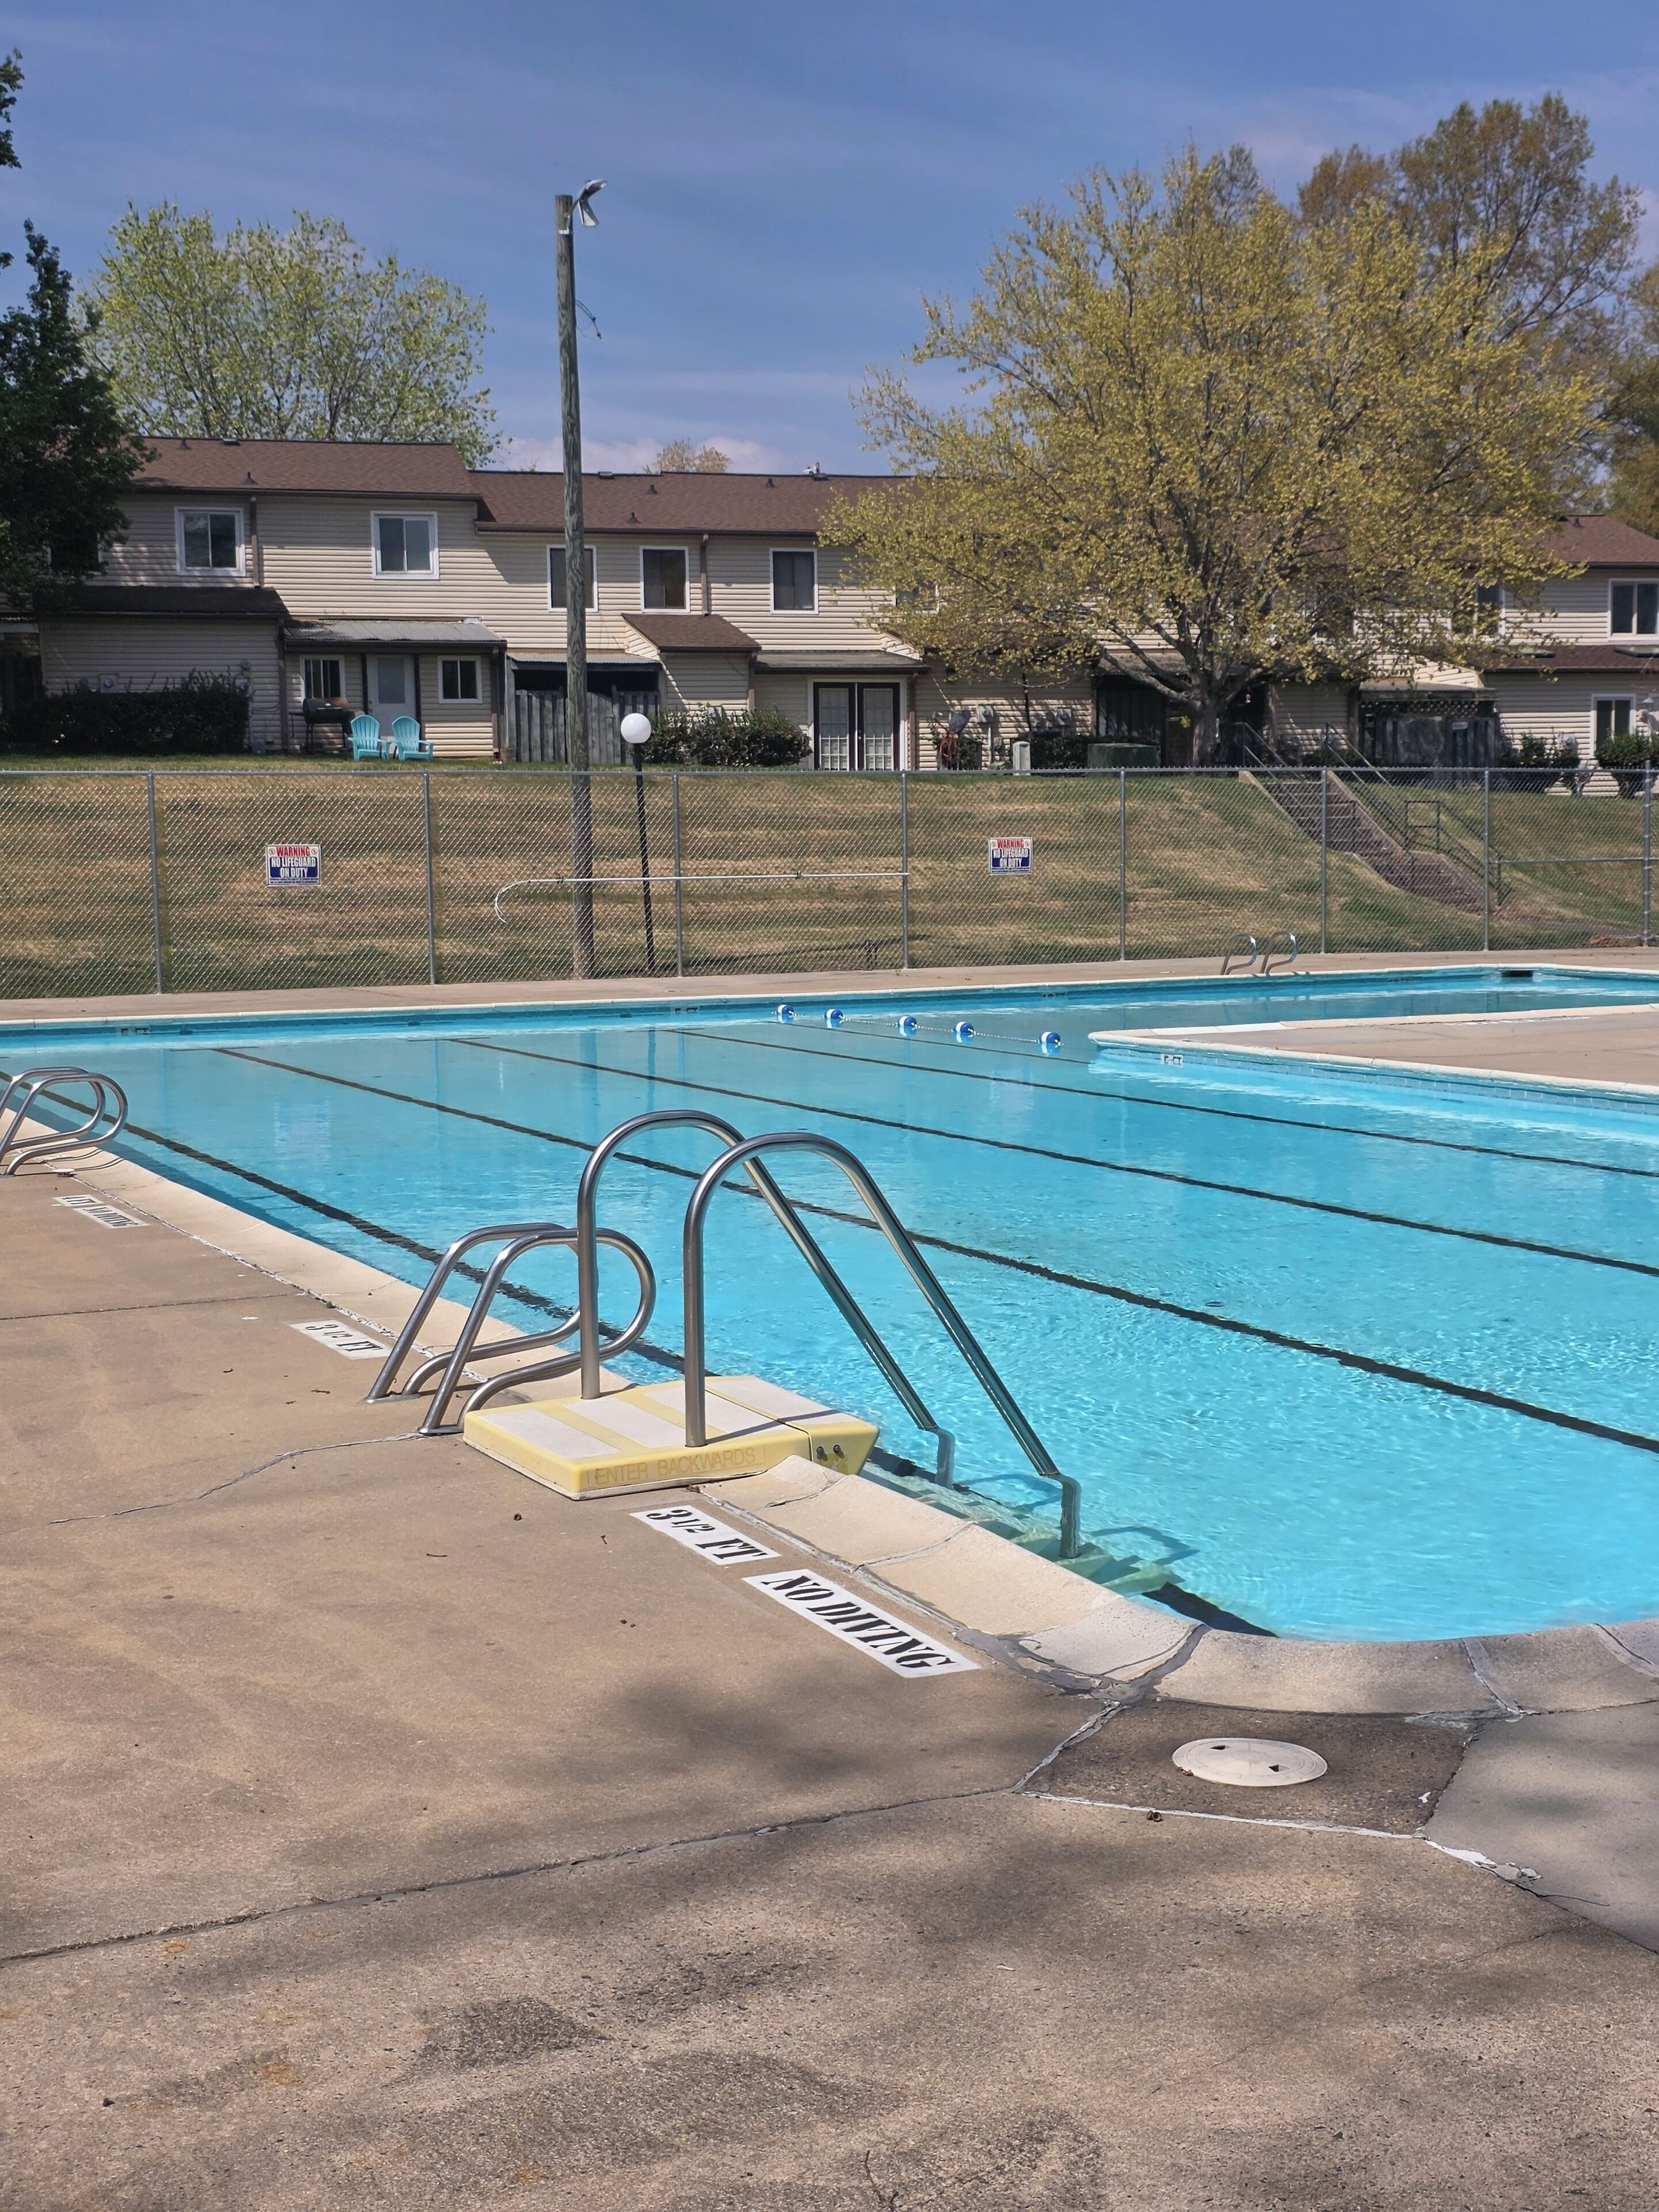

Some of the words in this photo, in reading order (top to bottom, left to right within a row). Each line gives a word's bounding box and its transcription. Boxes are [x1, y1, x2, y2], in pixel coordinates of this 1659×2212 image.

[997, 839, 1024, 848] WARNING
[276, 847, 310, 856] WARNING
[993, 849, 1001, 858] NO
[1002, 849, 1028, 858] LIFEGUARD
[271, 857, 281, 868] NO
[282, 857, 316, 867] LIFEGUARD
[1000, 858, 1007, 867] ON
[1008, 858, 1022, 867] DUTY
[280, 868, 289, 877] ON
[291, 868, 308, 877] DUTY
[336, 1340, 384, 1352] FT
[595, 1461, 649, 1486] ENTER
[657, 1446, 756, 1476] BACKWARDS
[646, 1509, 693, 1520] 3
[695, 1538, 768, 1559] FT
[760, 1575, 835, 1601] NO
[805, 1601, 957, 1669] DIVING
